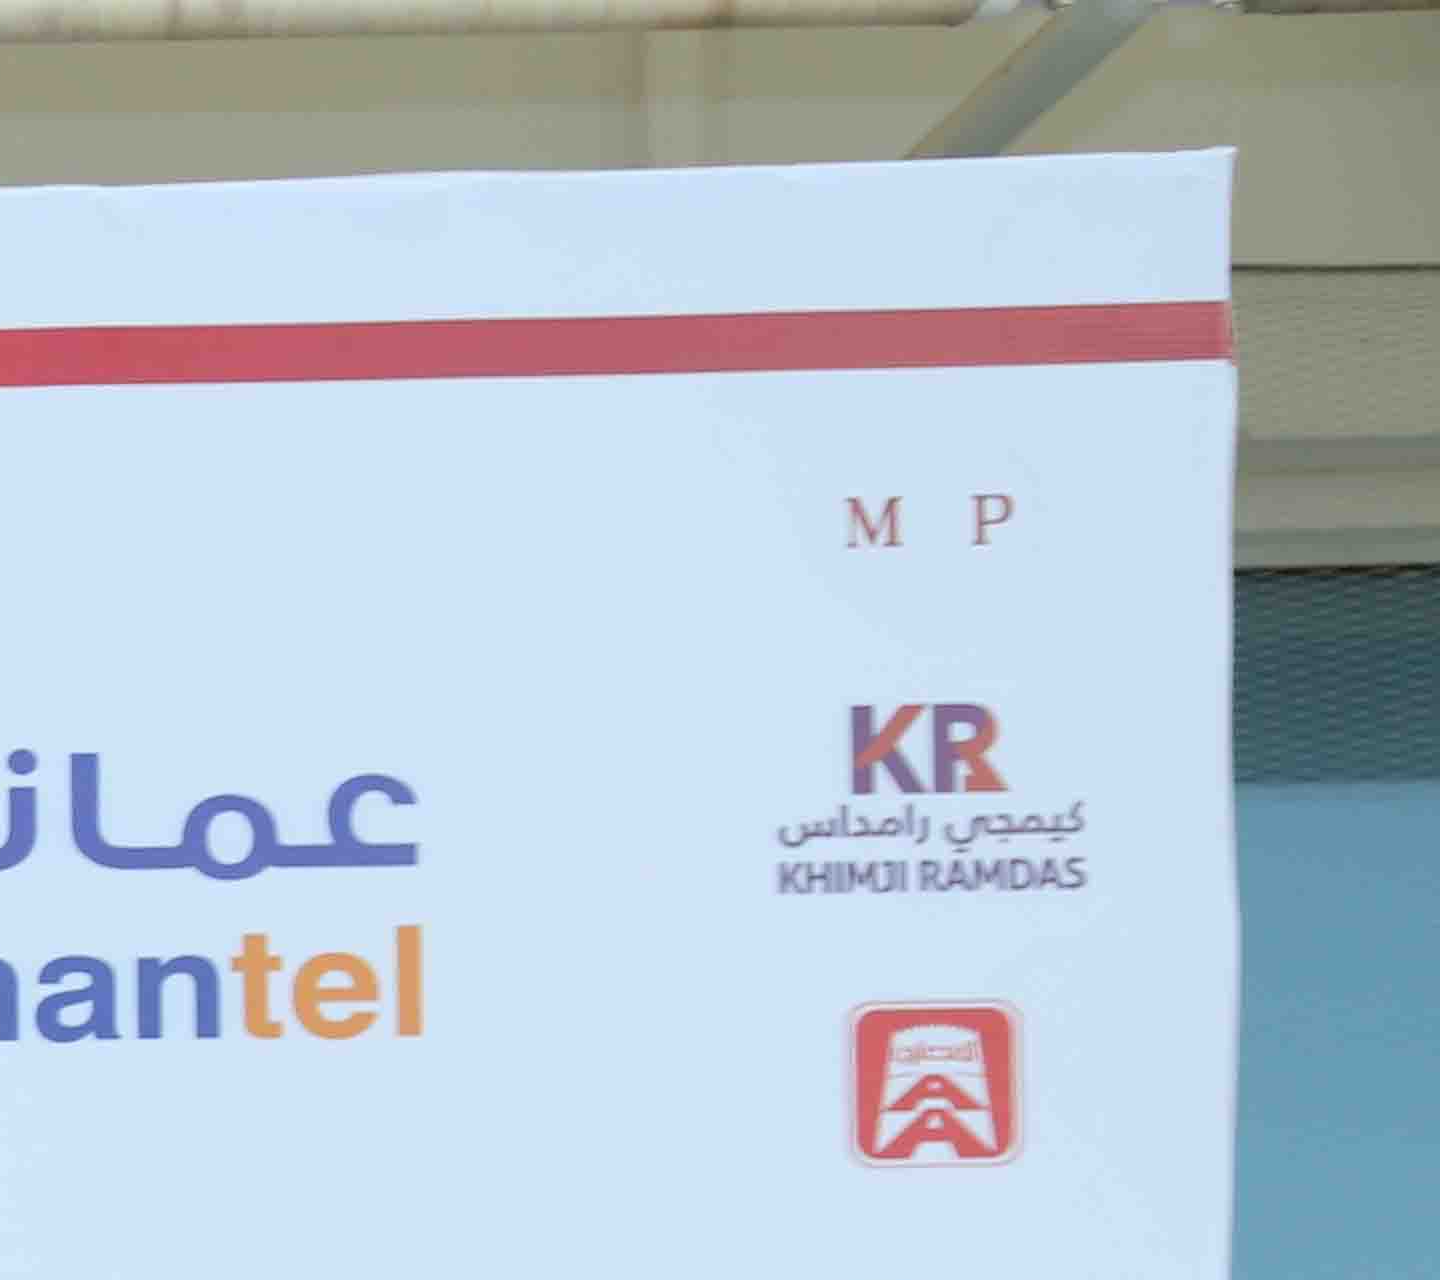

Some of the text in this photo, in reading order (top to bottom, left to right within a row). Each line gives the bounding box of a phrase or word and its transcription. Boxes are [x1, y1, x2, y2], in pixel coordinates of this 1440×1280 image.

[846, 494, 1013, 547] M P
[850, 703, 1008, 794] KR
[778, 857, 1088, 894] KHIMJI RAMDAS
